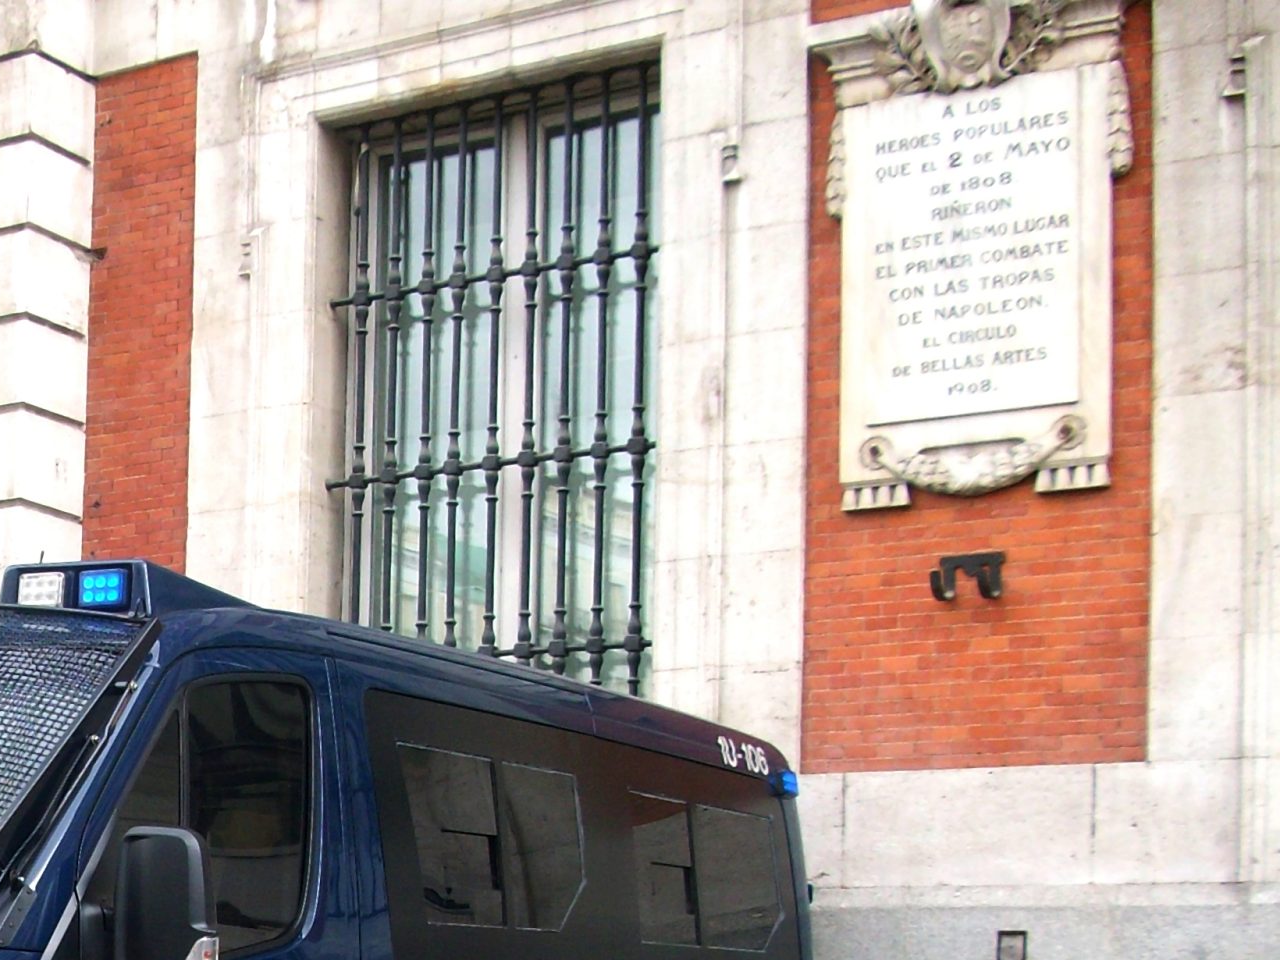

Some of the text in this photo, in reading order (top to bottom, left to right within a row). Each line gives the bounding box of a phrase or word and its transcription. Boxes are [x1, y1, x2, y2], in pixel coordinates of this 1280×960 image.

[942, 97, 1001, 119] A LOS
[875, 111, 1069, 155] HEROES POPULARES
[875, 137, 1071, 183] QUE EL 2 DE MAYO
[930, 171, 1013, 196] DE 1808
[931, 197, 1012, 221] RIÑERON
[875, 214, 1070, 255] EN ESTE MISMO LUGAR
[875, 240, 1069, 280] EL PRIMER COMBATE
[889, 268, 1055, 302] CON LAS TROPAS
[898, 311, 922, 327] DE
[922, 324, 1017, 349] EL CIRCULO
[892, 346, 1047, 377] DE BELLAS ARTES
